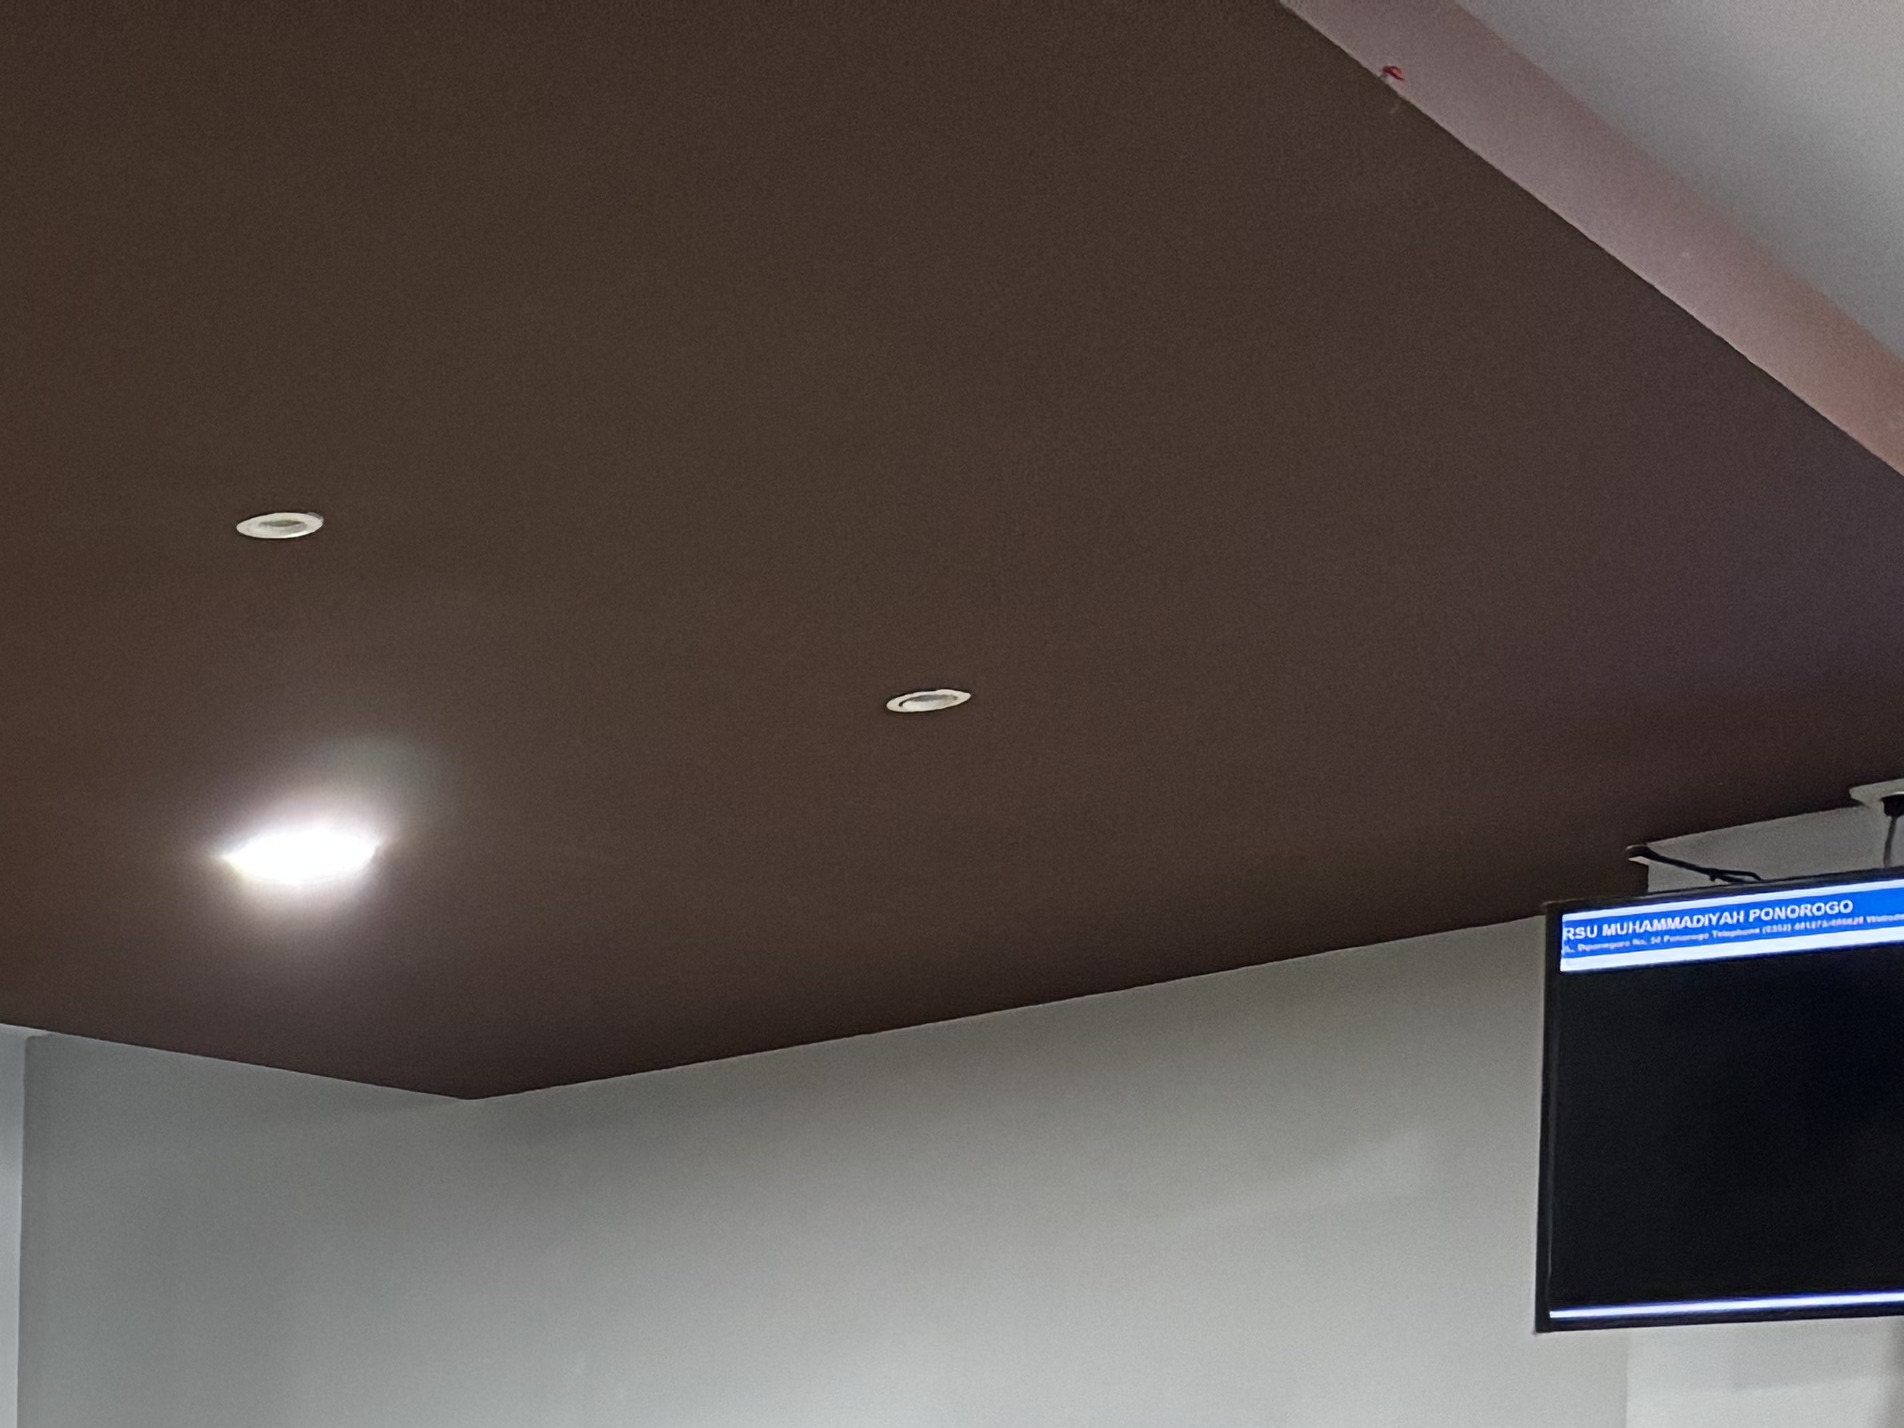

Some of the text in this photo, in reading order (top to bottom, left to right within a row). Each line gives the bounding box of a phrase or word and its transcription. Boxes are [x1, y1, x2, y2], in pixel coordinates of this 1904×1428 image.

[1564, 925, 1598, 940] RSU
[1602, 910, 1745, 936] MUHAMMADIYAH
[1748, 900, 1853, 922] PONOROGO
